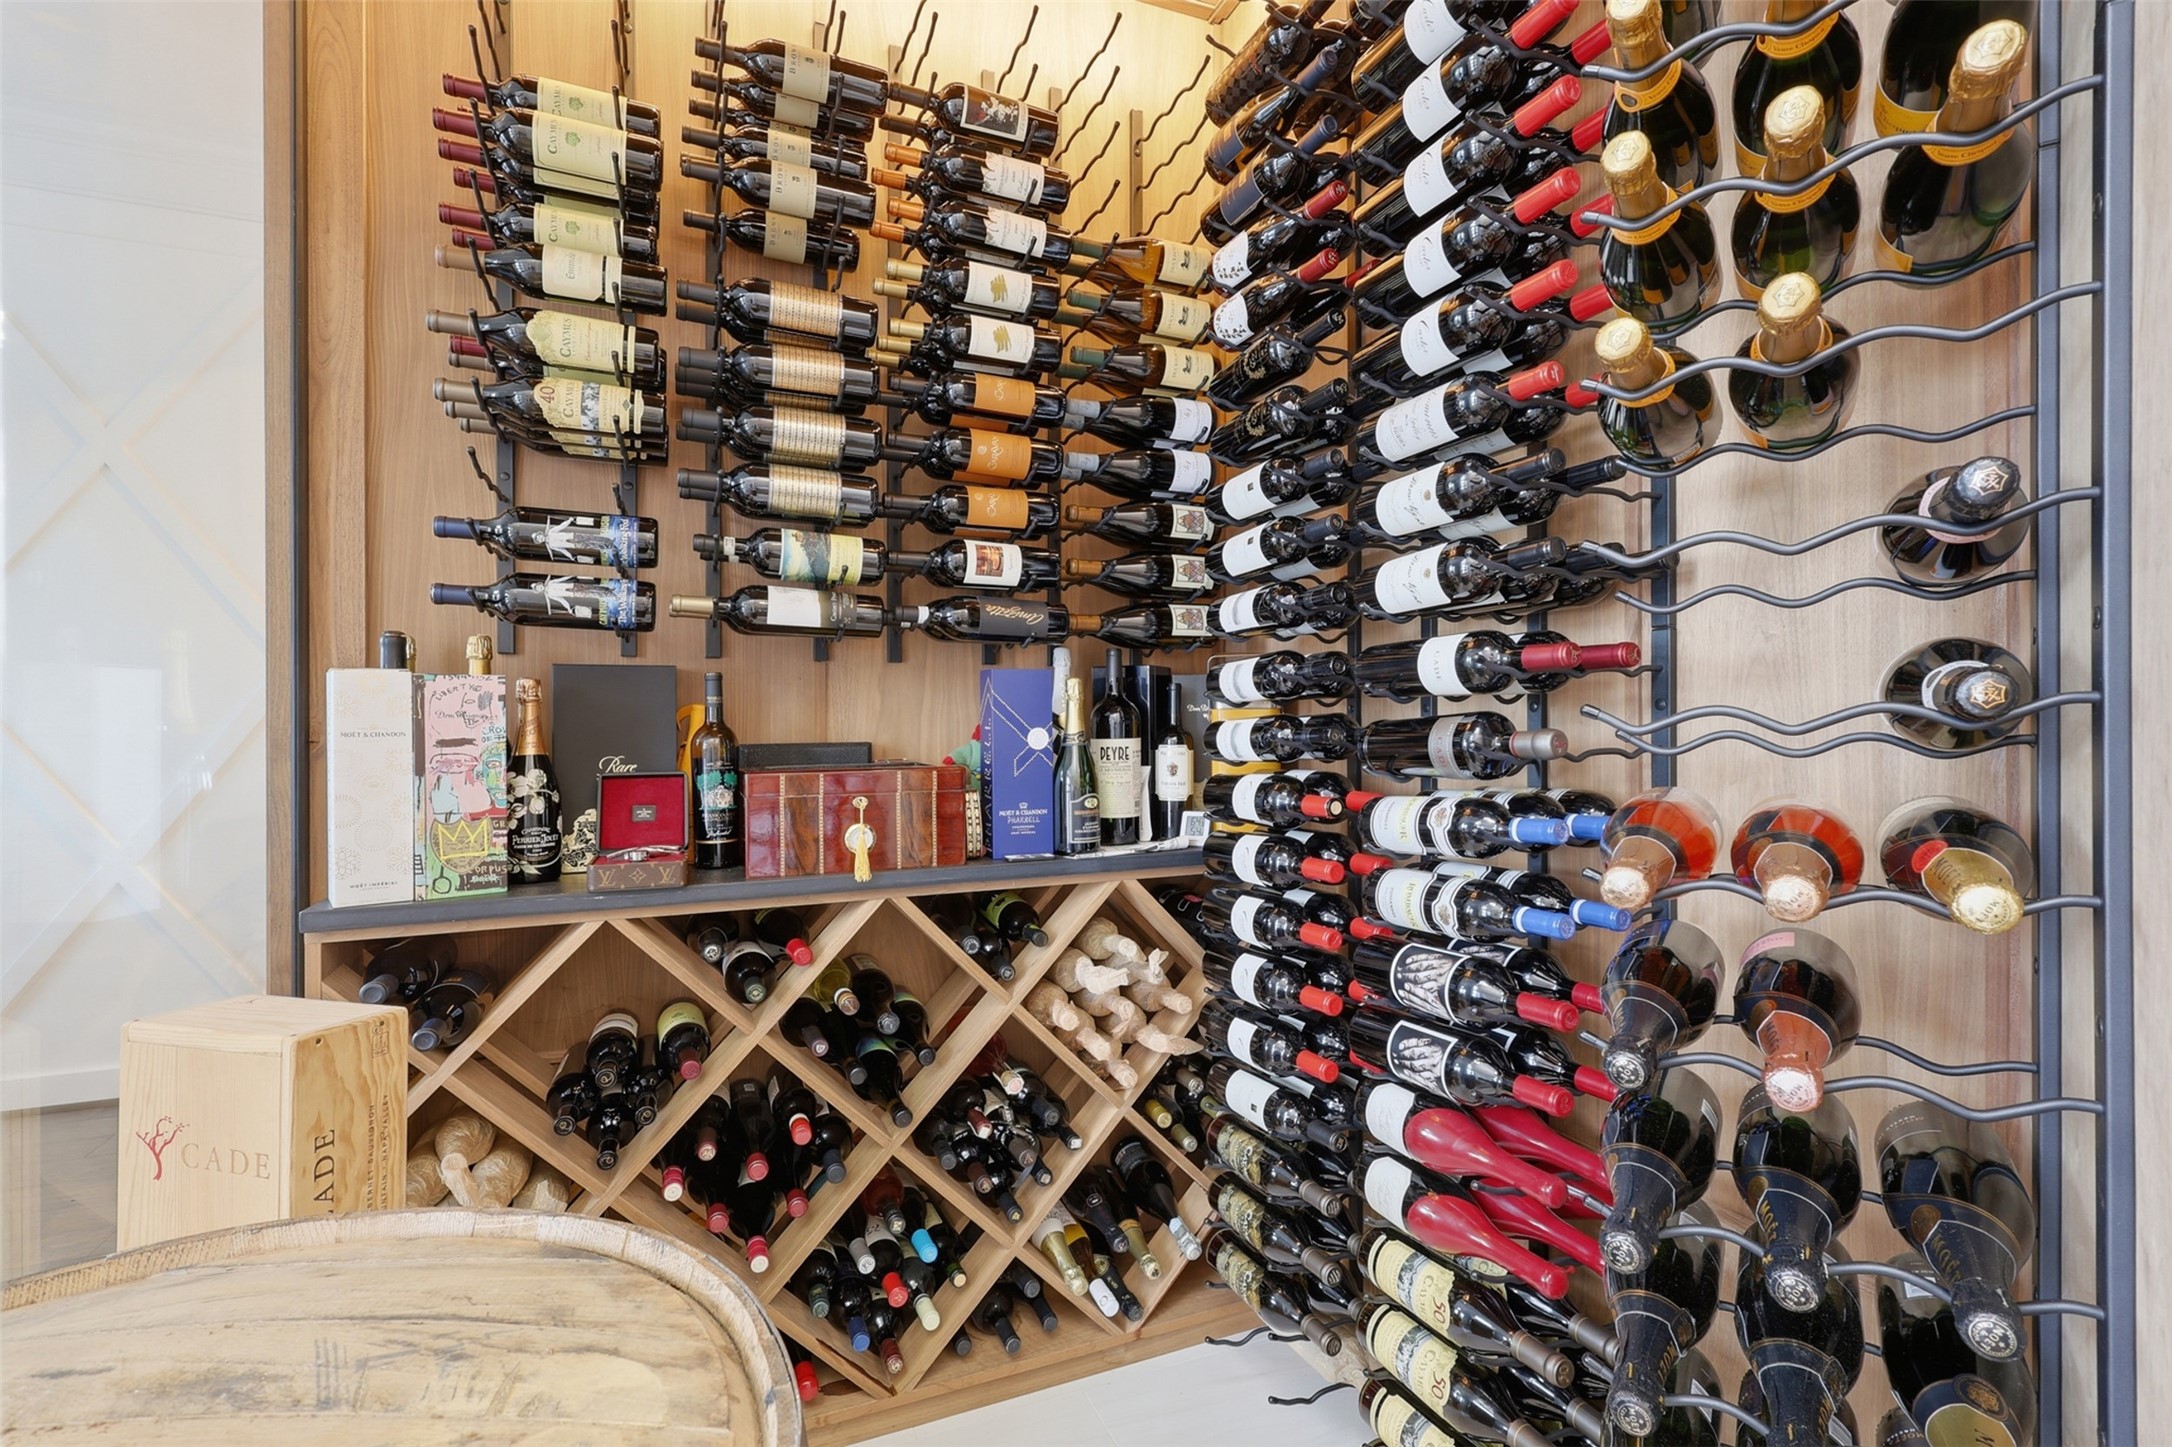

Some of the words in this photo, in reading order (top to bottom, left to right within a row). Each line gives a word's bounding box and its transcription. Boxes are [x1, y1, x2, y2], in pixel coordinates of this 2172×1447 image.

[560, 318, 572, 358] CAYMUS
[544, 386, 560, 405] 40
[563, 381, 574, 419] CAYMUS
[985, 602, 1046, 625] Amizetta
[598, 755, 638, 774] Rare
[181, 1142, 271, 1180] CADE
[313, 1129, 335, 1213] ADE
[1432, 1296, 1447, 1324] 50
[1431, 1371, 1447, 1401] 50
